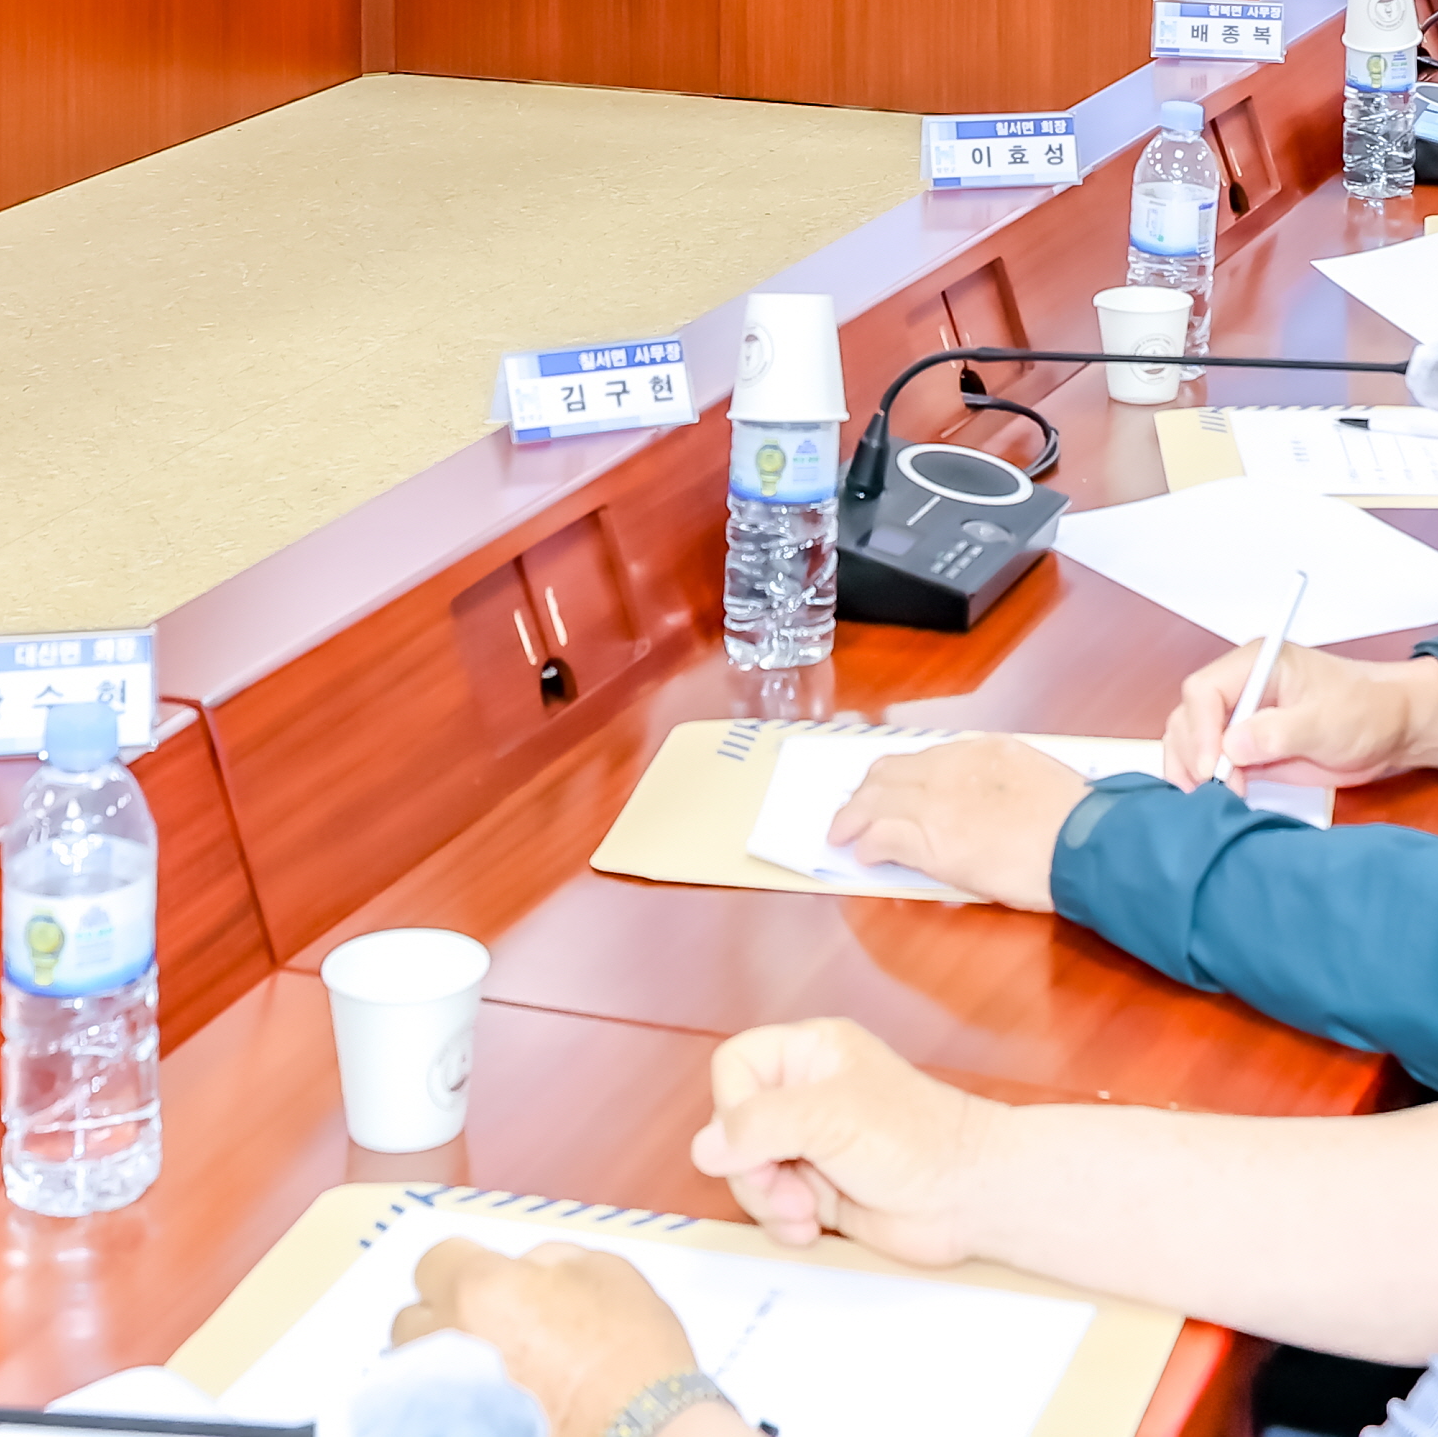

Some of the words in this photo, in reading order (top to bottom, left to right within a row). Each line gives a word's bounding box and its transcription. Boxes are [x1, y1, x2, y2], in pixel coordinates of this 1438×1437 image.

[1246, 6, 1282, 19] 사무장
[1190, 23, 1272, 45] 배종복
[995, 120, 1035, 136] 칠서면
[1040, 119, 1067, 134] 회장
[971, 142, 1065, 168] 이효성
[577, 347, 628, 371] 칠서면
[633, 341, 681, 364] 사무장
[560, 373, 674, 413] 김구현
